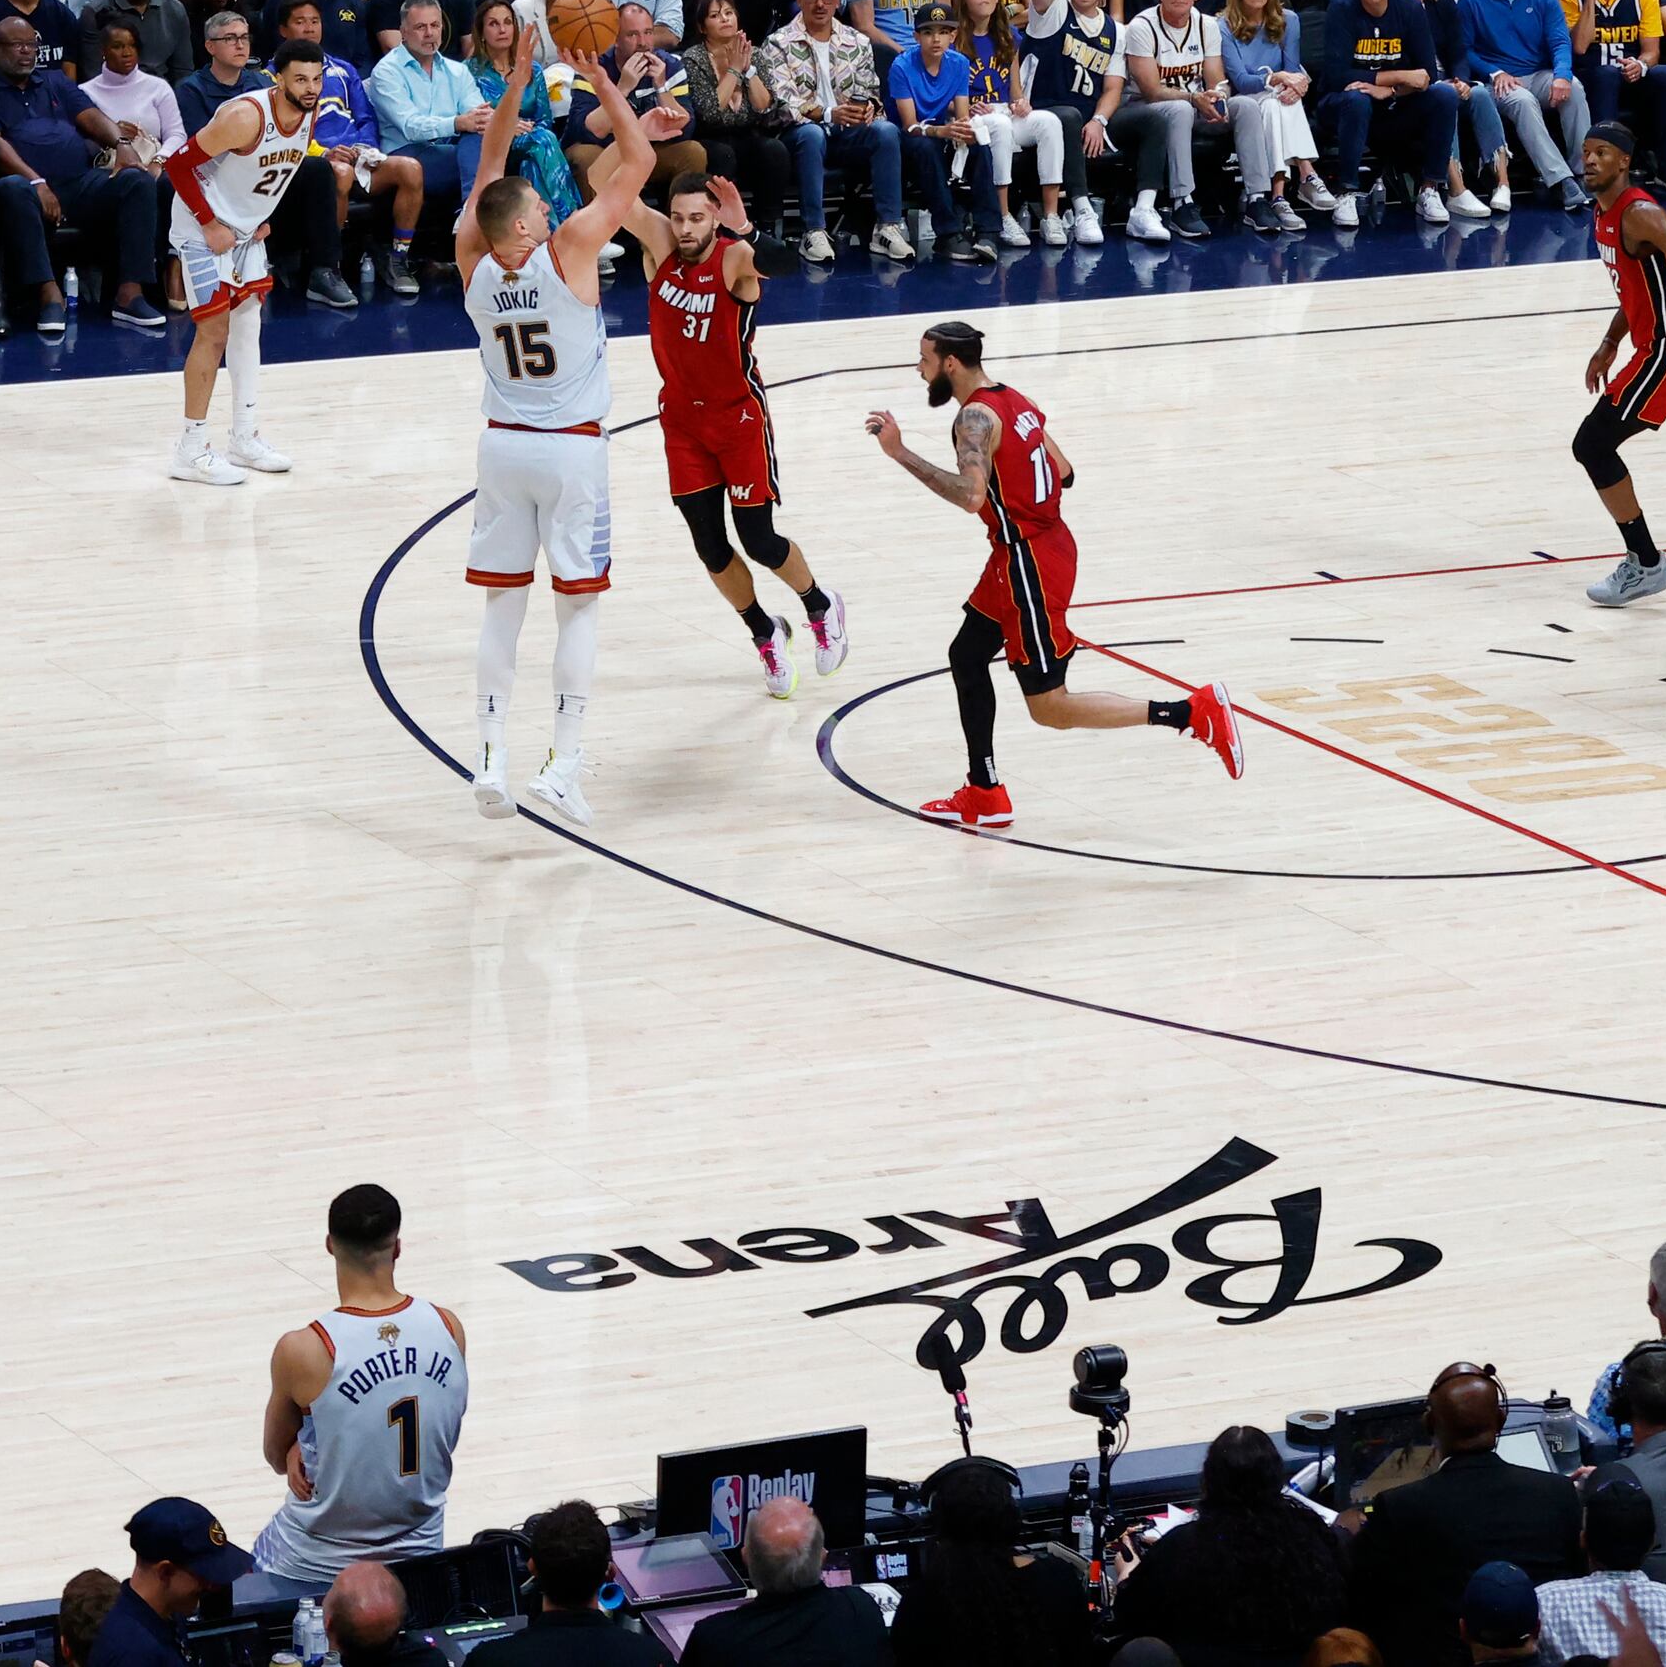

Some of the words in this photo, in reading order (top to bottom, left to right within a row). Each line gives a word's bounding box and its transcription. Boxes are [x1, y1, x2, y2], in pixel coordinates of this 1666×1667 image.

[1595, 23, 1641, 44] ENVER
[1062, 30, 1114, 75] DENVER
[1599, 43, 1627, 68] 15
[1071, 64, 1096, 97] 15
[259, 149, 303, 169] DENVER
[252, 168, 294, 198] 27
[492, 287, 540, 314] JOKIĆ
[658, 279, 716, 314] MIAMI
[682, 314, 712, 343] 31
[493, 321, 558, 381] 15
[499, 1197, 1058, 1293] Arena
[804, 1135, 1444, 1372] Ball
[337, 1346, 419, 1407] PORTER
[424, 1351, 452, 1390] JR.
[388, 1395, 420, 1476] 1
[746, 1468, 816, 1507] Replay
